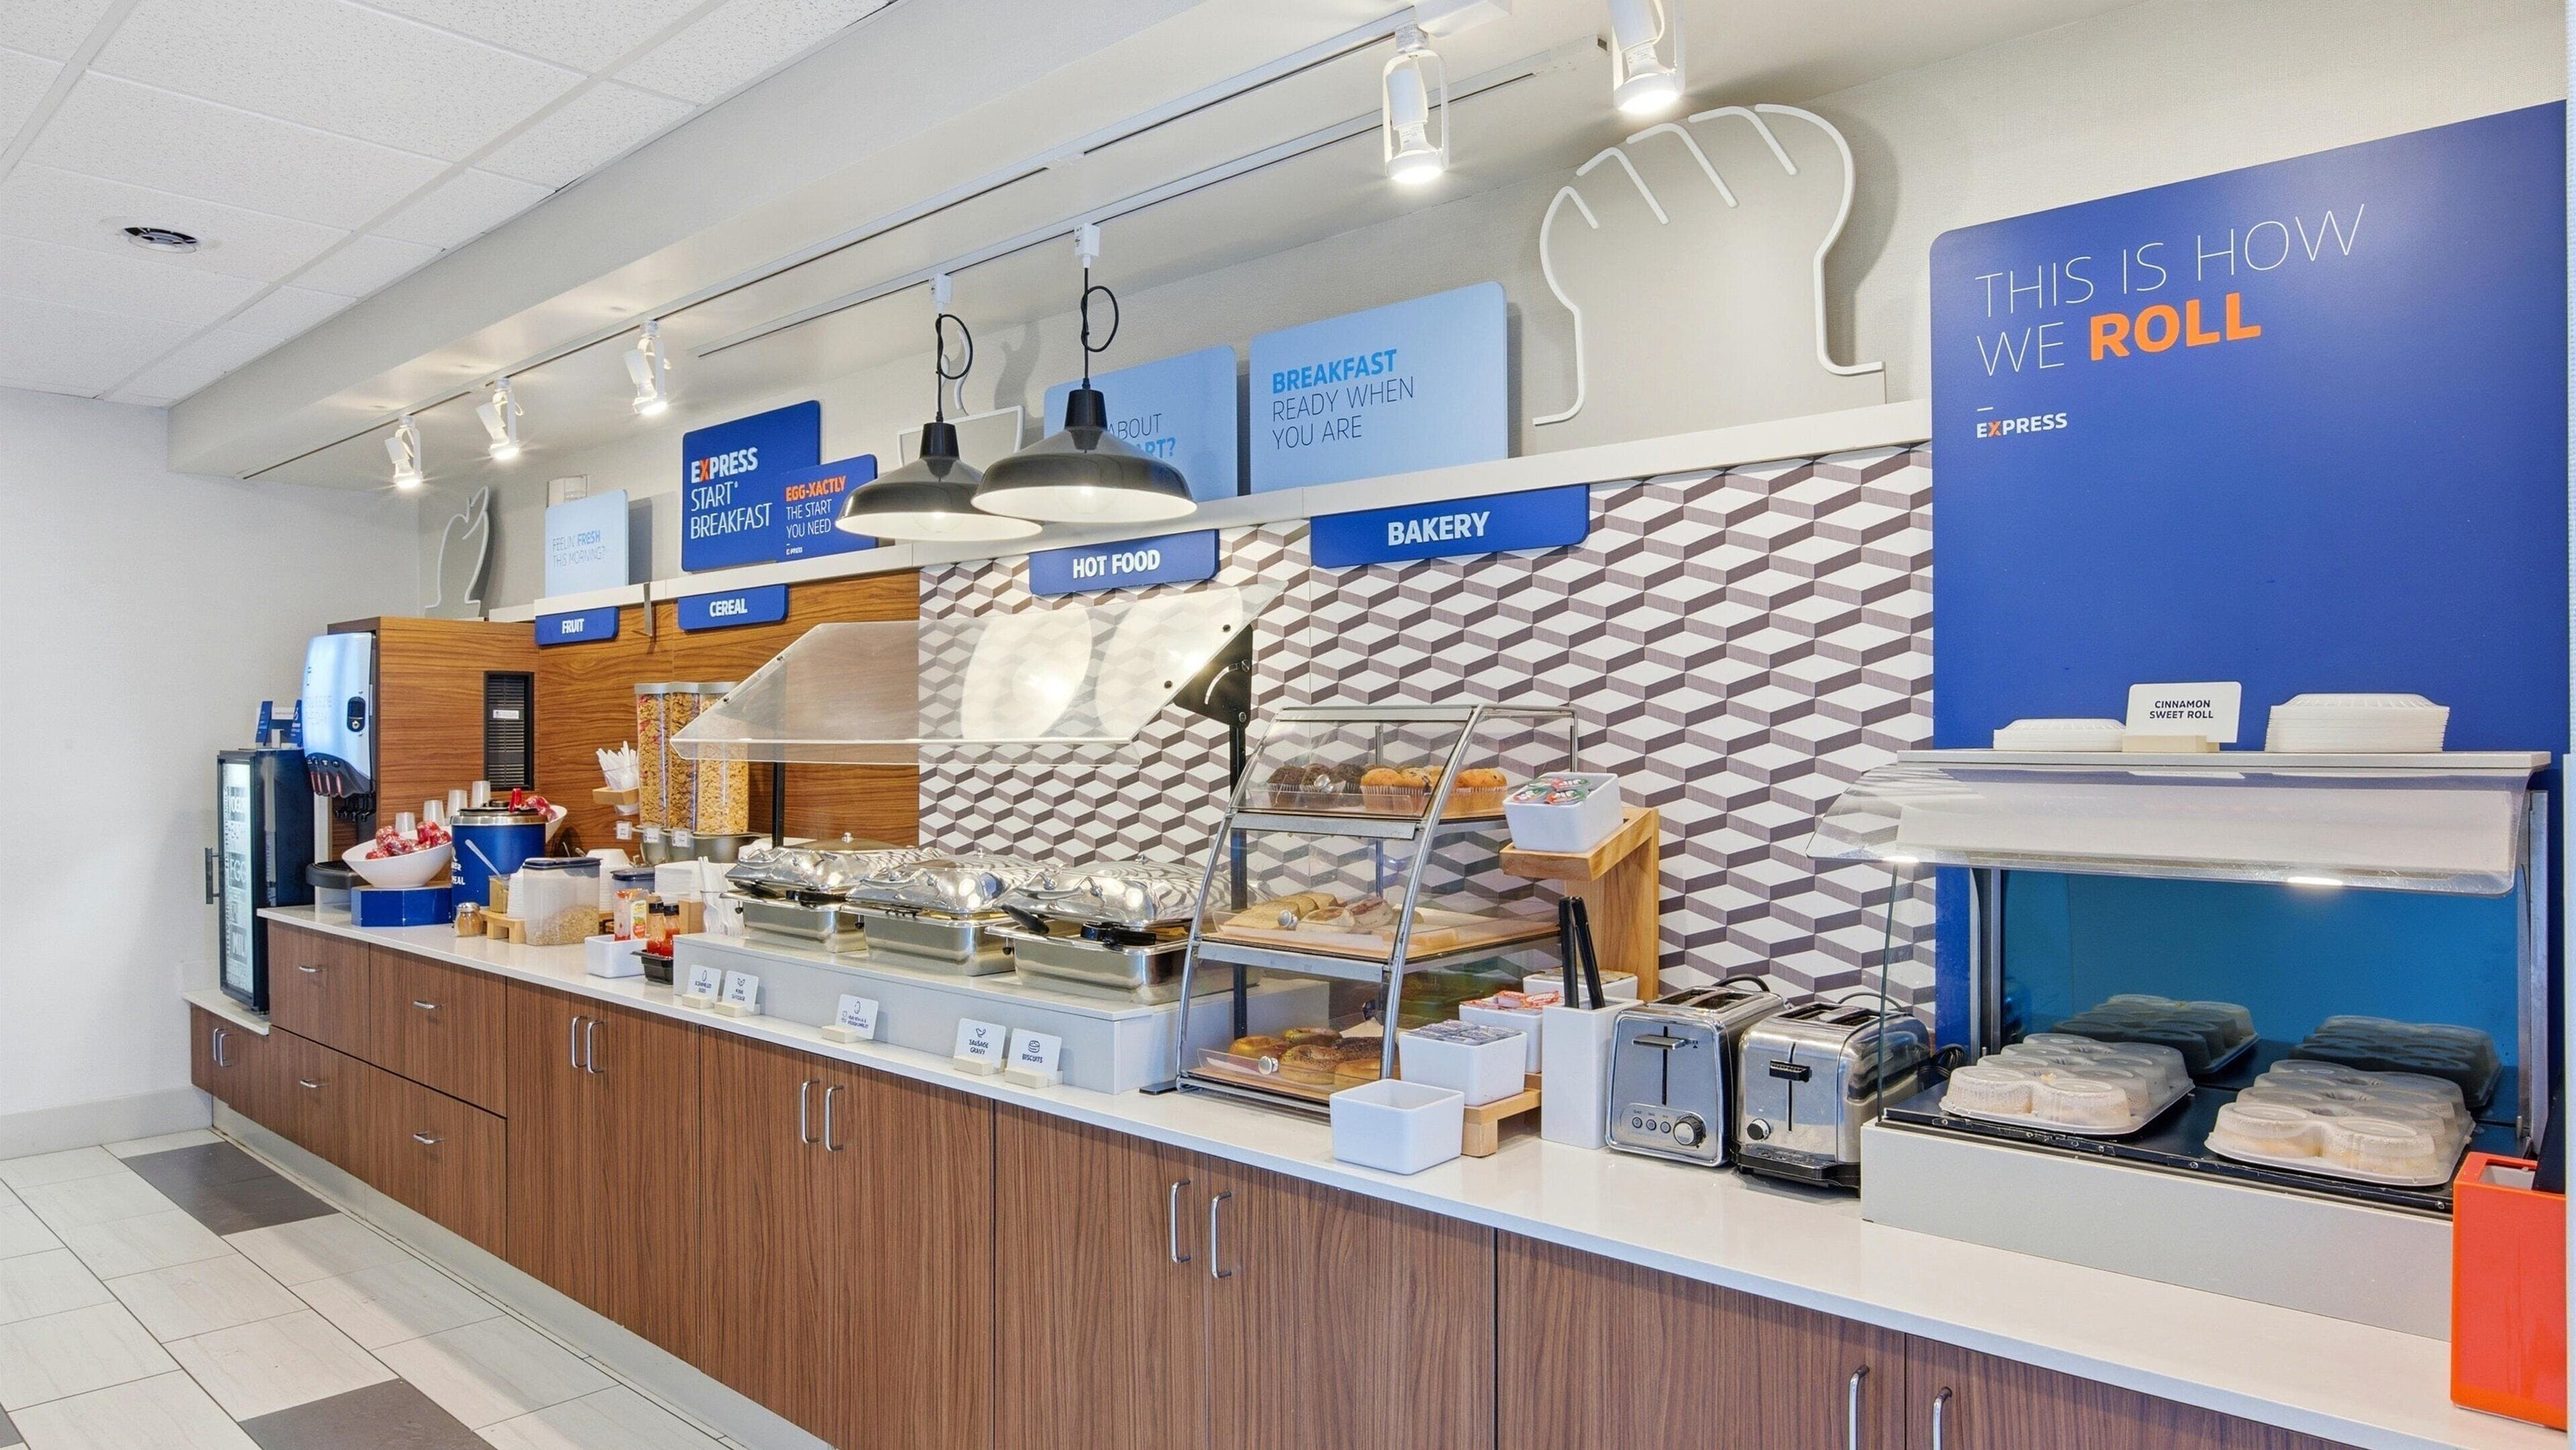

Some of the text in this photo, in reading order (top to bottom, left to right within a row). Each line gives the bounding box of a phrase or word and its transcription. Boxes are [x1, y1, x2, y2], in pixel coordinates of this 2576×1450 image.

[1975, 203, 2365, 318] THIS IS HOW
[1977, 292, 2261, 376] WE ROLL
[1273, 348, 1397, 395] BREAKFAST
[1273, 376, 1414, 422] READY WHEN
[1273, 415, 1362, 450] YOU ARE
[1977, 413, 2068, 438] EXPRESS
[691, 446, 758, 483] EXPRESS
[786, 475, 846, 502] EGG-XACTLY
[691, 502, 773, 539] BREAKFAST
[786, 499, 832, 520] THE START
[577, 530, 601, 546] FRESH
[786, 518, 832, 539] YOU NEED
[1388, 511, 1491, 546] BAKERY
[553, 552, 567, 567] THIS
[1073, 549, 1160, 579] HOT FOOD
[709, 597, 748, 618] CEREAL
[561, 618, 585, 634] FRUIT
[2149, 710, 2214, 719] SWEET ROLL
[2154, 699, 2211, 709] CINNAMON
[1022, 1053, 1043, 1063] BISCUITS
